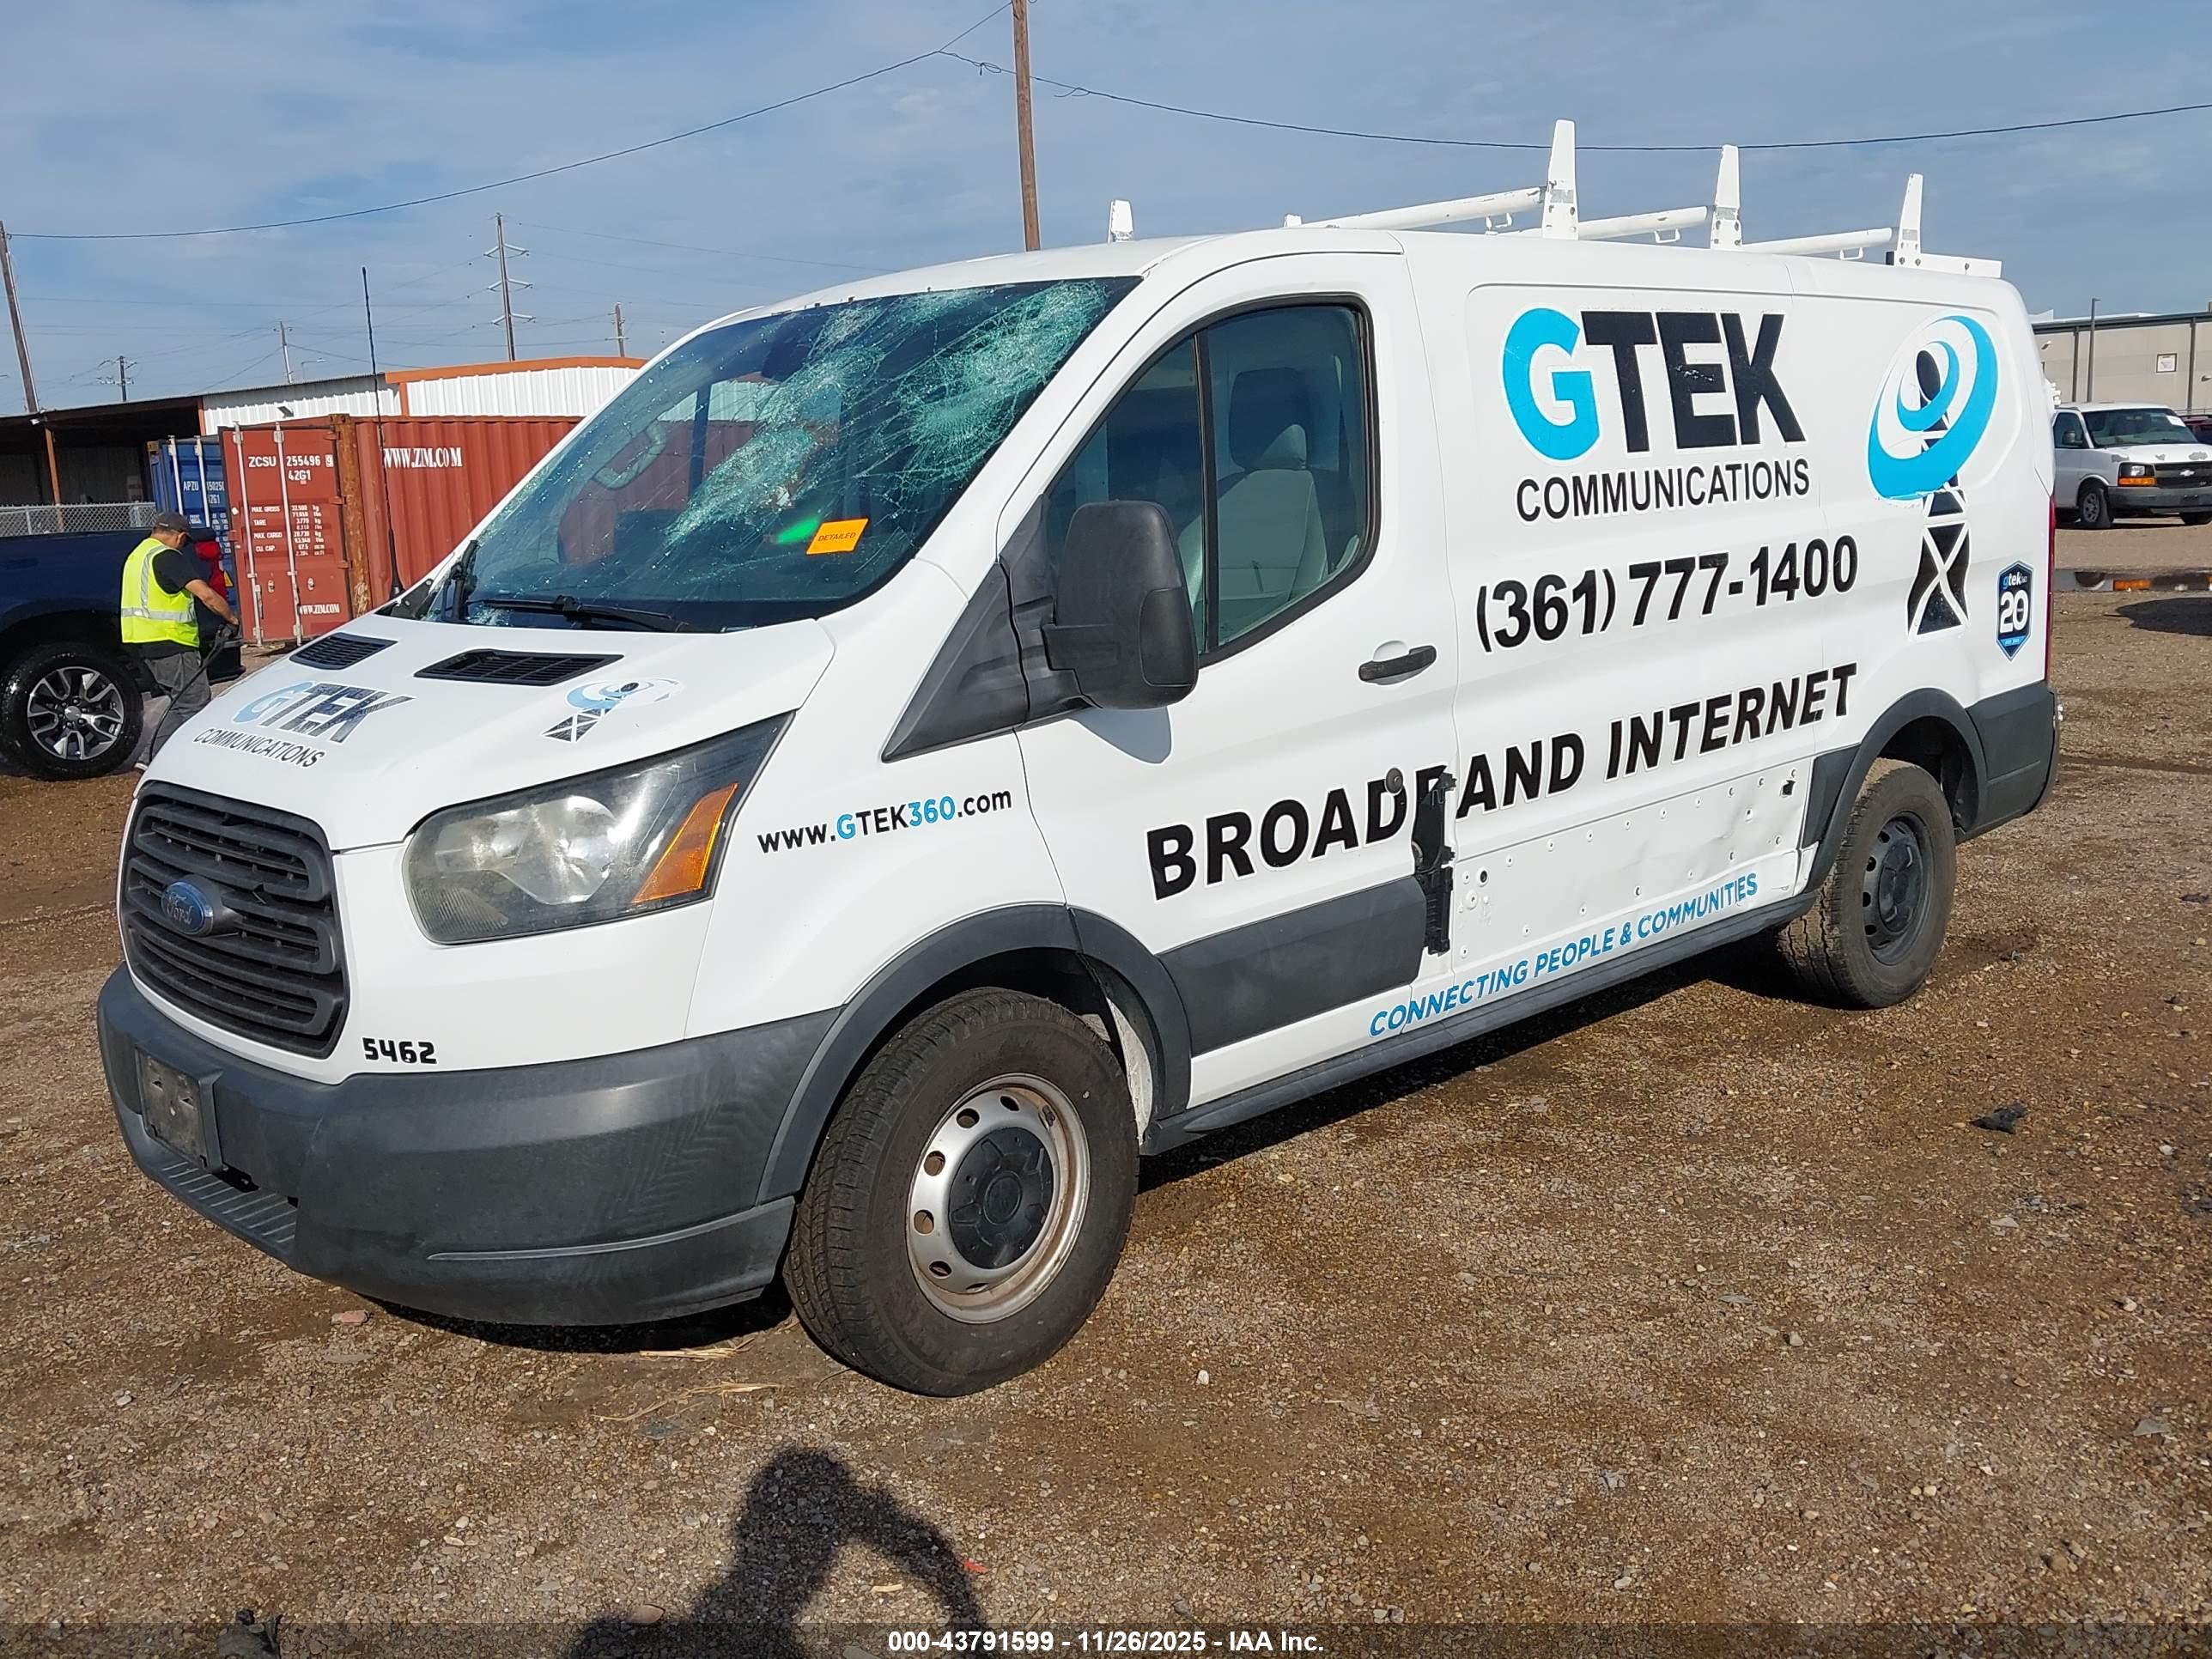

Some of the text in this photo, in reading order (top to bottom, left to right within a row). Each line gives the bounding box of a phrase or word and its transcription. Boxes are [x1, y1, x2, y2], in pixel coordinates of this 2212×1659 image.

[1502, 307, 1808, 461] GTEK
[247, 456, 276, 468] ZCSU
[286, 455, 321, 467] 255496
[289, 470, 311, 481] 42G1
[183, 481, 199, 491] APZU
[1516, 459, 1810, 522] COMMUNICATIONS
[817, 532, 857, 543] DETAILED
[1476, 534, 1858, 653] (361) 777-1400
[2000, 590, 2028, 633] 20
[233, 681, 416, 744] GTEK
[1605, 662, 1857, 781] INTERNET
[193, 728, 326, 768] COMMUNICATIONS
[757, 790, 1012, 854] www.GTEK360.com
[166, 891, 193, 925] Ford
[1369, 872, 1758, 1037] CONNECTING PEOPLE & COMMUNITIES
[362, 1037, 438, 1064] 5462
